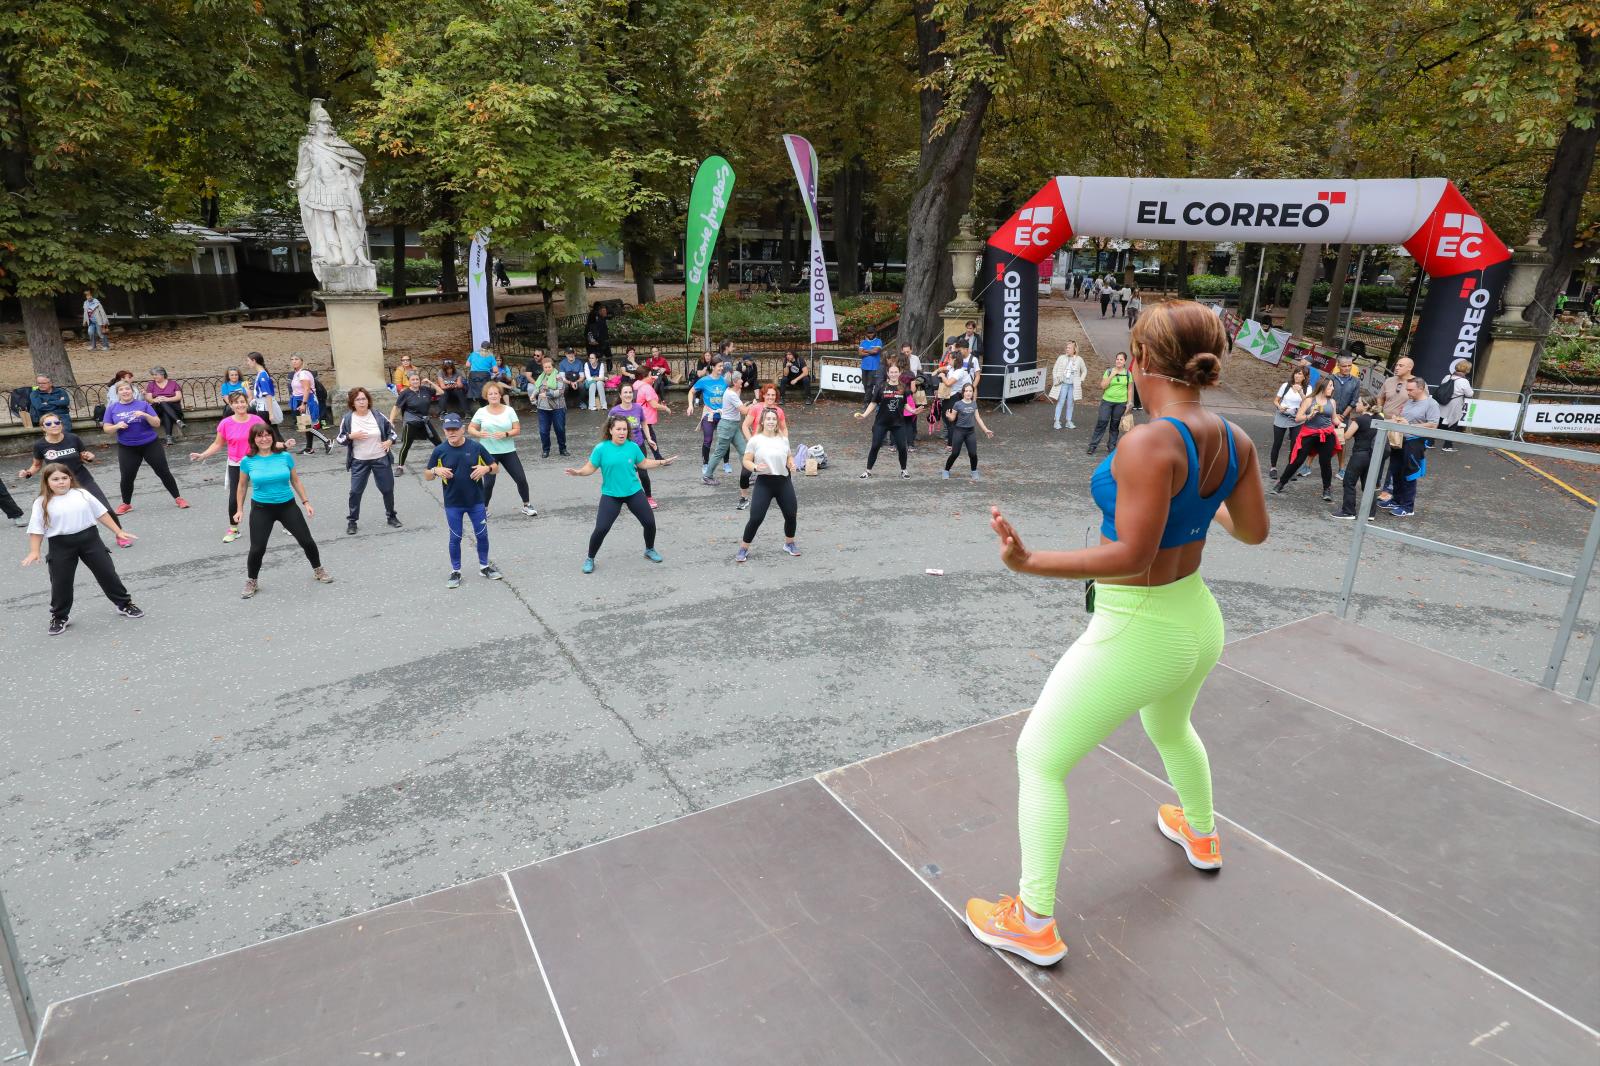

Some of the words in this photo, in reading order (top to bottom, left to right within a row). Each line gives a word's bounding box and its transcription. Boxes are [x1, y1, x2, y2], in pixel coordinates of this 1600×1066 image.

[701, 165, 729, 230] Inglés
[1137, 200, 1176, 224] EL
[1182, 201, 1330, 228] CORREO
[694, 227, 712, 267] Corte
[1014, 226, 1050, 246] EC
[1436, 236, 1483, 259] EC
[1003, 270, 1021, 364] CORREO
[832, 373, 845, 383] EL
[1010, 379, 1017, 389] EL
[1018, 375, 1039, 387] CORREO
[1535, 411, 1552, 423] EL
